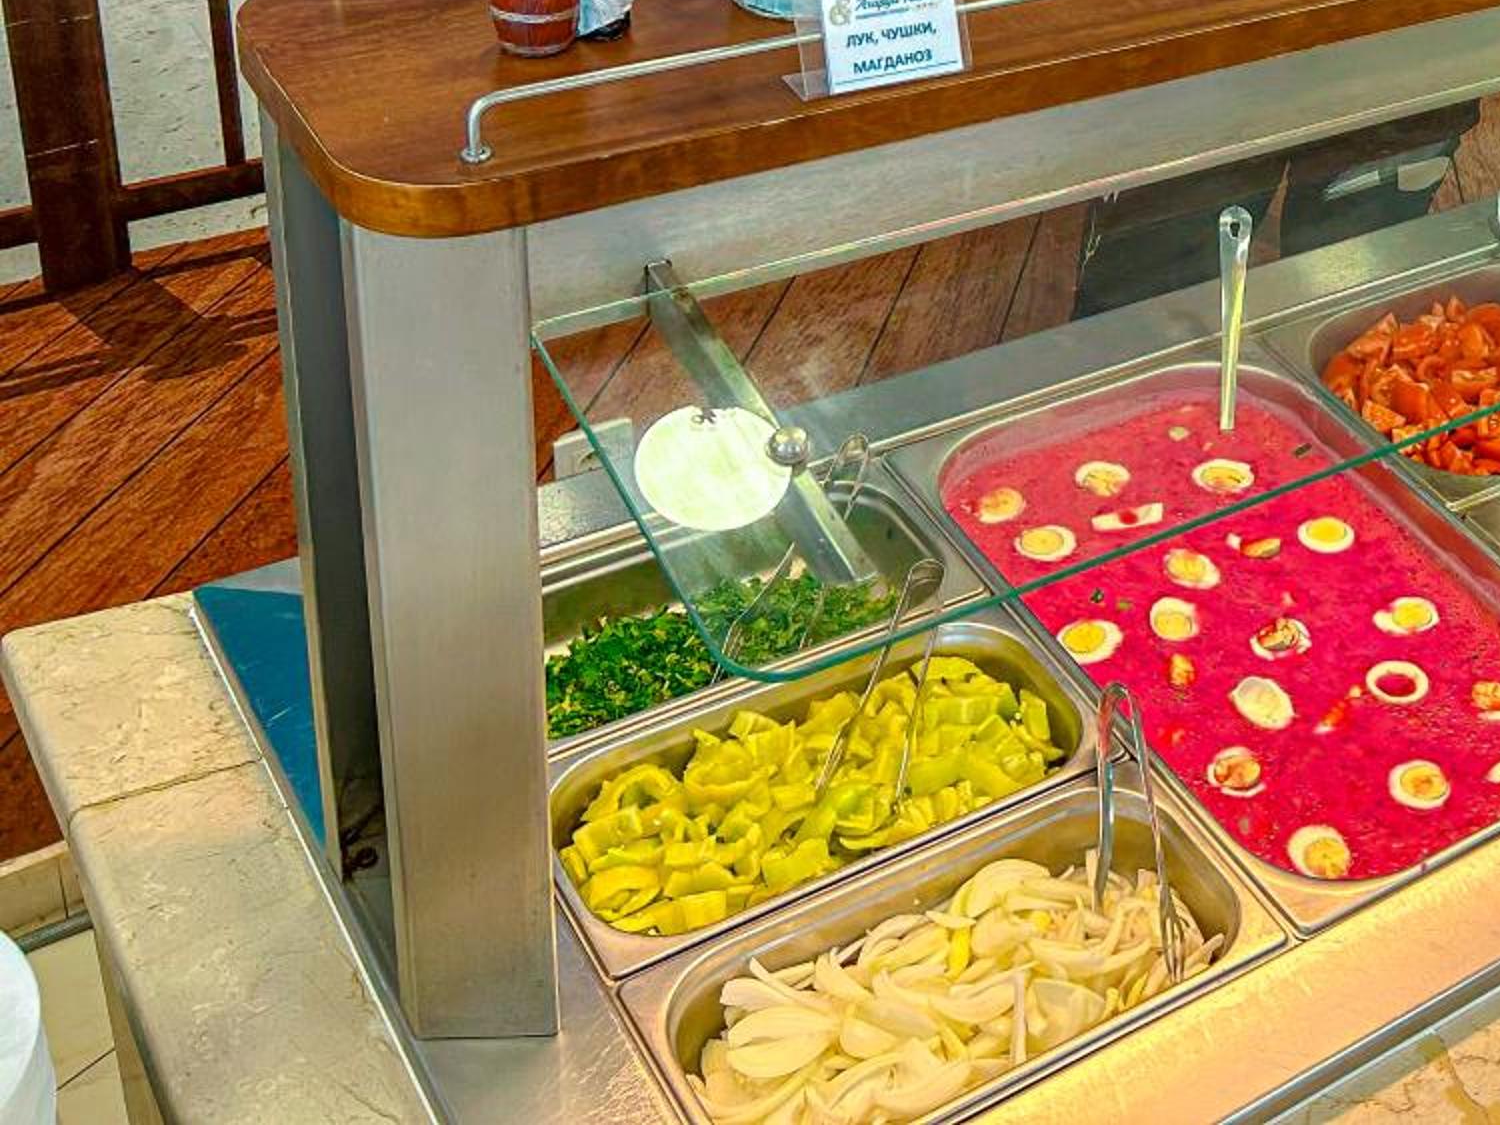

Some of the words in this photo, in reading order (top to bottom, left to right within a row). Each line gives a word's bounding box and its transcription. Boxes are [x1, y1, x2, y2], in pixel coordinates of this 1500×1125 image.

[846, 32, 879, 49] ЛУК,
[881, 21, 937, 40] ЧУШКИ,
[853, 48, 933, 74] МАГДАНОЗ
